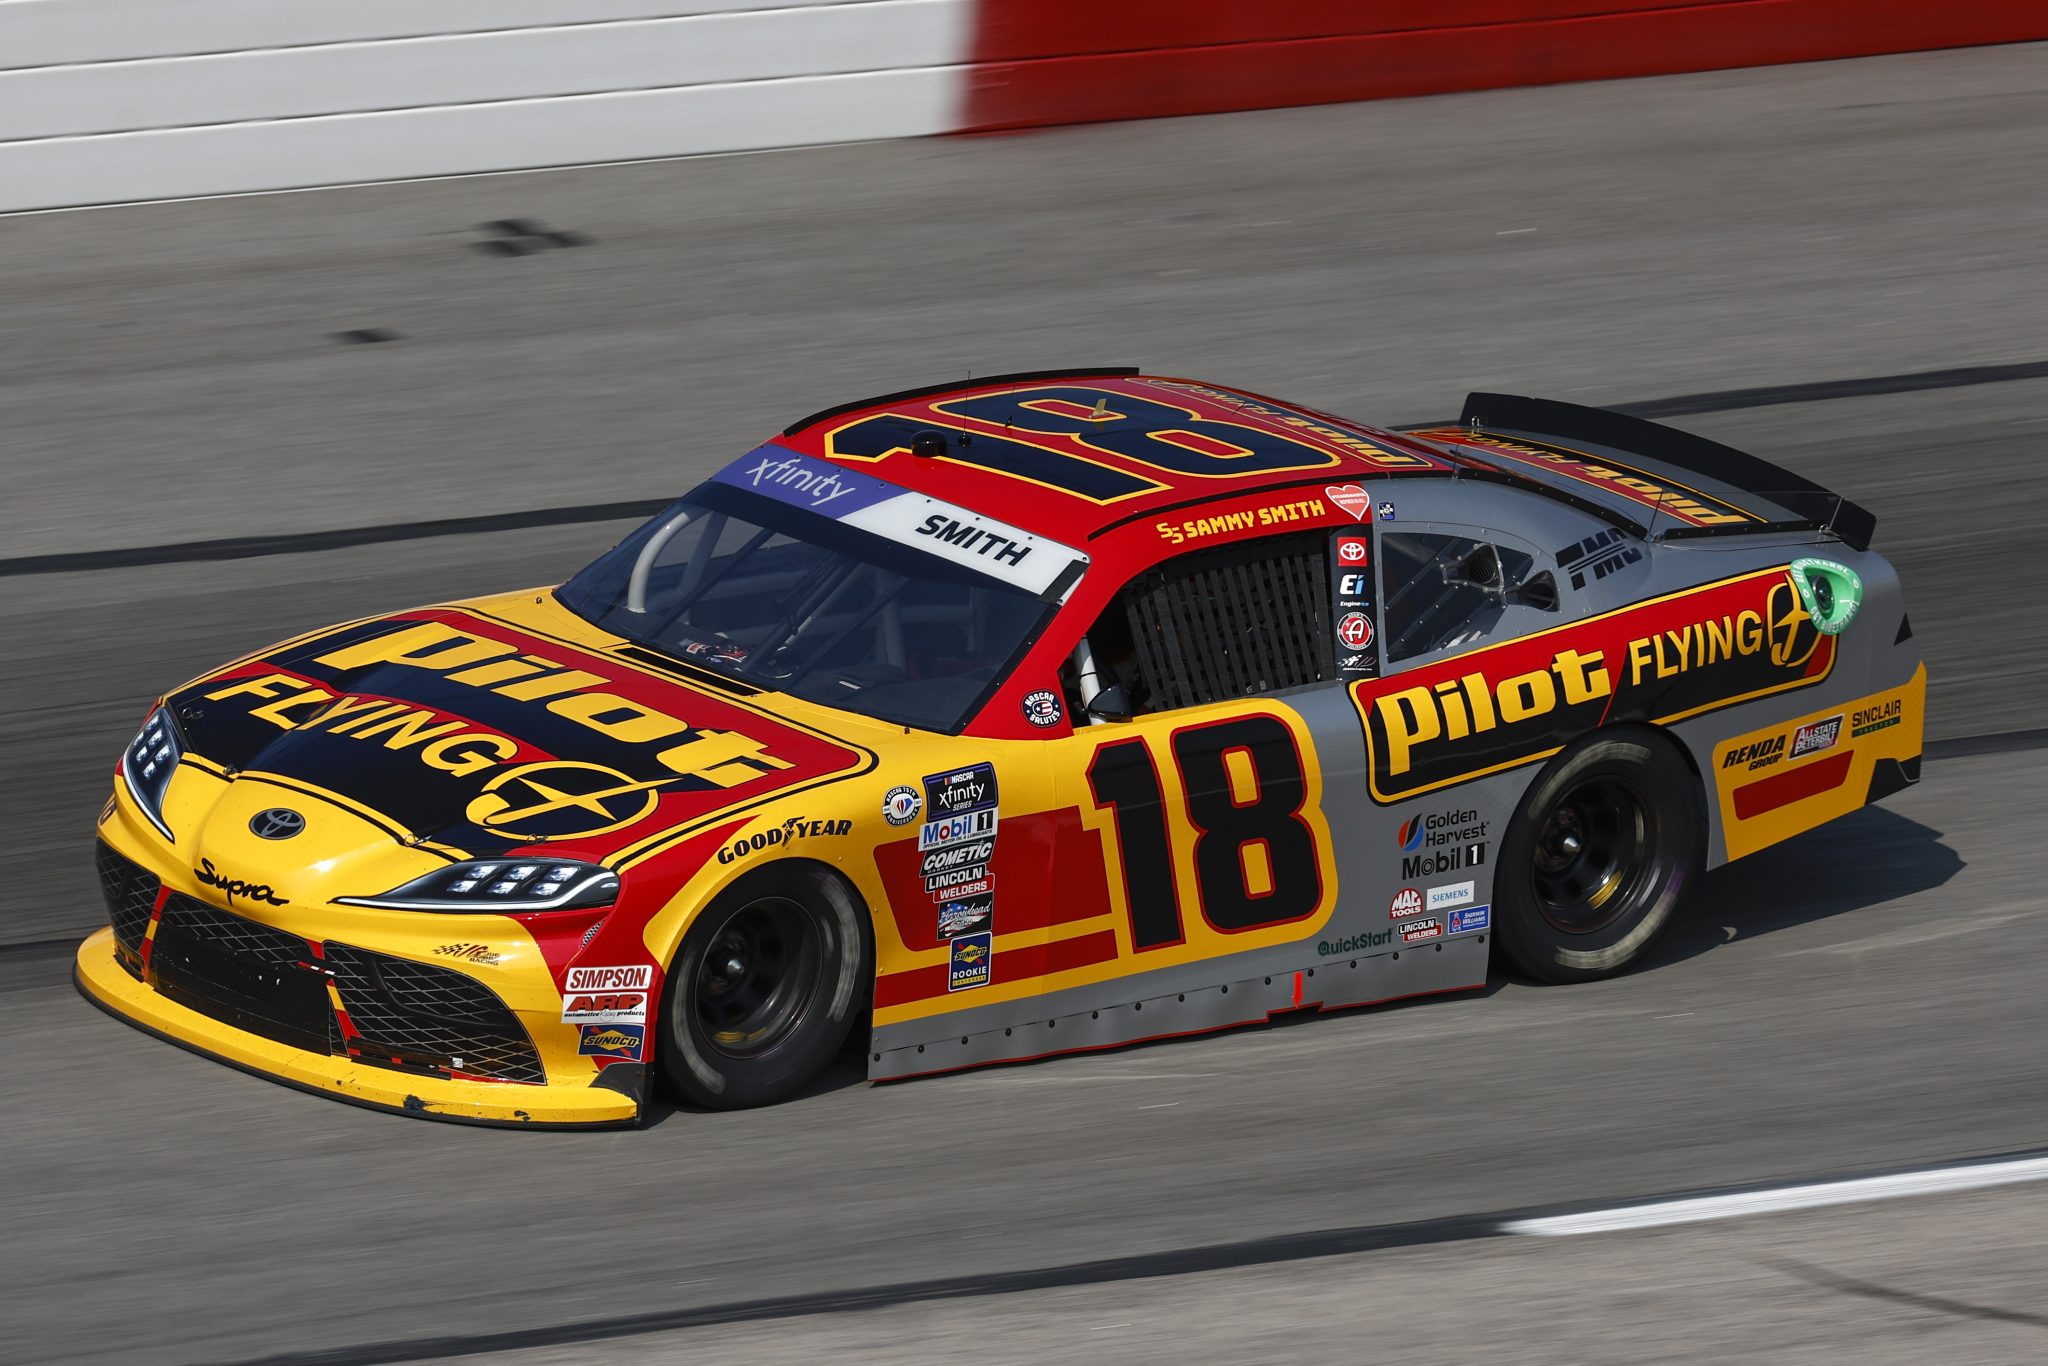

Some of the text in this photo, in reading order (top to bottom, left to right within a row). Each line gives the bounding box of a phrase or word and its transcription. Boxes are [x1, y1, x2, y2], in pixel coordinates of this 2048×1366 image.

[824, 385, 1343, 505] 18
[746, 456, 856, 507] xfinity
[1183, 510, 1255, 538] SAMMY
[1258, 499, 1326, 526] SMITH
[914, 514, 1032, 567] SMITH
[1629, 609, 1763, 687] FLYING
[1024, 692, 1055, 707] NASCAR
[1030, 710, 1061, 725] SALUTES
[1851, 699, 1901, 728] SINCLAIR
[203, 672, 519, 779] FLYING
[1798, 721, 1839, 742] ALLSTATE
[1722, 734, 1787, 770] RENDA
[1748, 752, 1783, 772] GROUP
[951, 771, 974, 784] NASCAR
[939, 782, 985, 808] xfinity
[952, 800, 973, 812] SERIES
[923, 815, 973, 845] Mobil
[1425, 809, 1478, 830] Golden
[1085, 712, 1324, 954] 18
[1425, 822, 1487, 848] Harvest
[923, 842, 993, 871] COMETIC
[1402, 847, 1461, 880] Mobil
[193, 857, 290, 907] Supra
[928, 867, 982, 890] LINCOLN
[939, 881, 988, 900] WELDERS
[1391, 889, 1422, 911] MAG
[1431, 888, 1469, 903] SIEMENS
[1391, 906, 1422, 918] TOOLS
[1399, 919, 1435, 934] LINCOLN
[1407, 928, 1438, 941] WELDERS
[956, 947, 987, 960] SUNOCO
[1317, 930, 1392, 956] QuickStart
[569, 968, 647, 989] SIMPSON
[952, 966, 987, 980] ROOKIE
[565, 994, 644, 1012] ARP
[585, 1036, 637, 1046] SUNOCO
